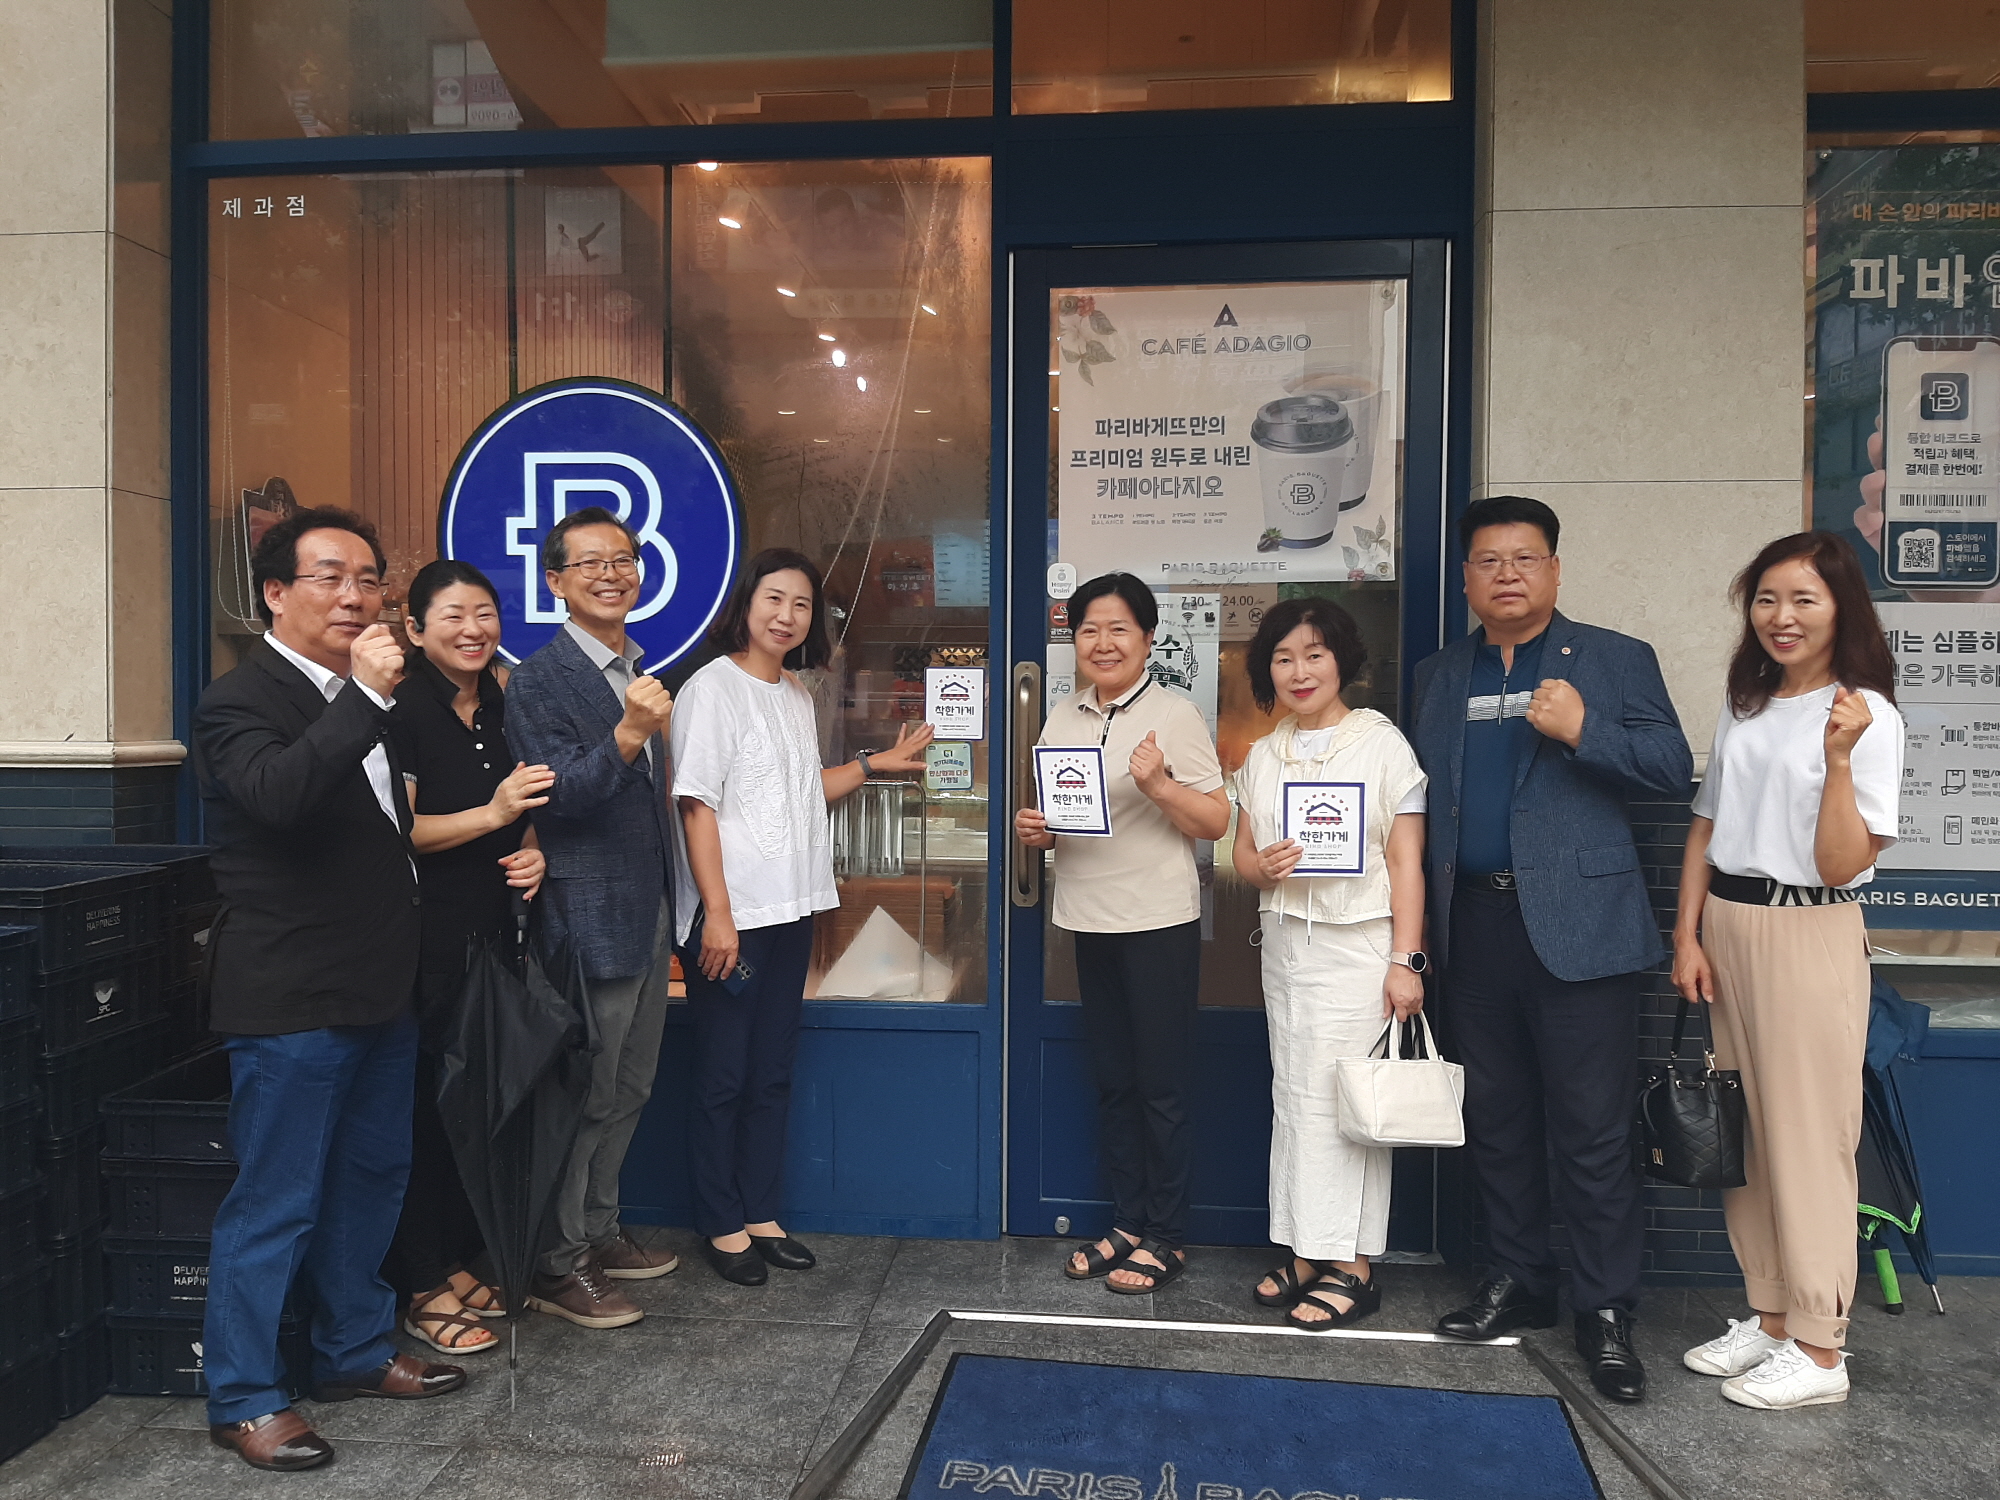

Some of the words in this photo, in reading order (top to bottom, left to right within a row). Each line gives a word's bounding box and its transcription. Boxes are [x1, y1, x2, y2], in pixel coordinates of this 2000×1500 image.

[1853, 203, 1872, 221] 내
[1877, 204, 1899, 222] 손
[1141, 333, 1206, 356] CAFÉ
[1214, 334, 1312, 353] ADAGIO
[1095, 415, 1225, 438] 파리바게뜨만의
[1907, 433, 1931, 444] 통합
[1933, 433, 1982, 444] 바코드로
[1070, 447, 1143, 469] 프리미엄
[1151, 447, 1207, 468] 원두로
[1214, 446, 1251, 467] 내린
[1913, 448, 1948, 460] 적립과
[1951, 448, 1979, 460] 혜택,
[1905, 464, 1940, 476] 결제를
[1943, 463, 1983, 476] 한번에!
[1096, 475, 1224, 500] 카페아다지오
[1946, 534, 1986, 542] 스토어에서
[1946, 554, 1987, 563] 검색하세요
[1162, 563, 1203, 573] PARIS
[1209, 561, 1287, 572] BAGUETTE
[1222, 595, 1254, 607] 24.00
[935, 705, 975, 717] 착한가게
[1052, 794, 1093, 806] 착한가게
[1299, 830, 1349, 843] 착한가게
[1914, 892, 2000, 907] BAGUET
[86, 915, 121, 932] HAPPINESS
